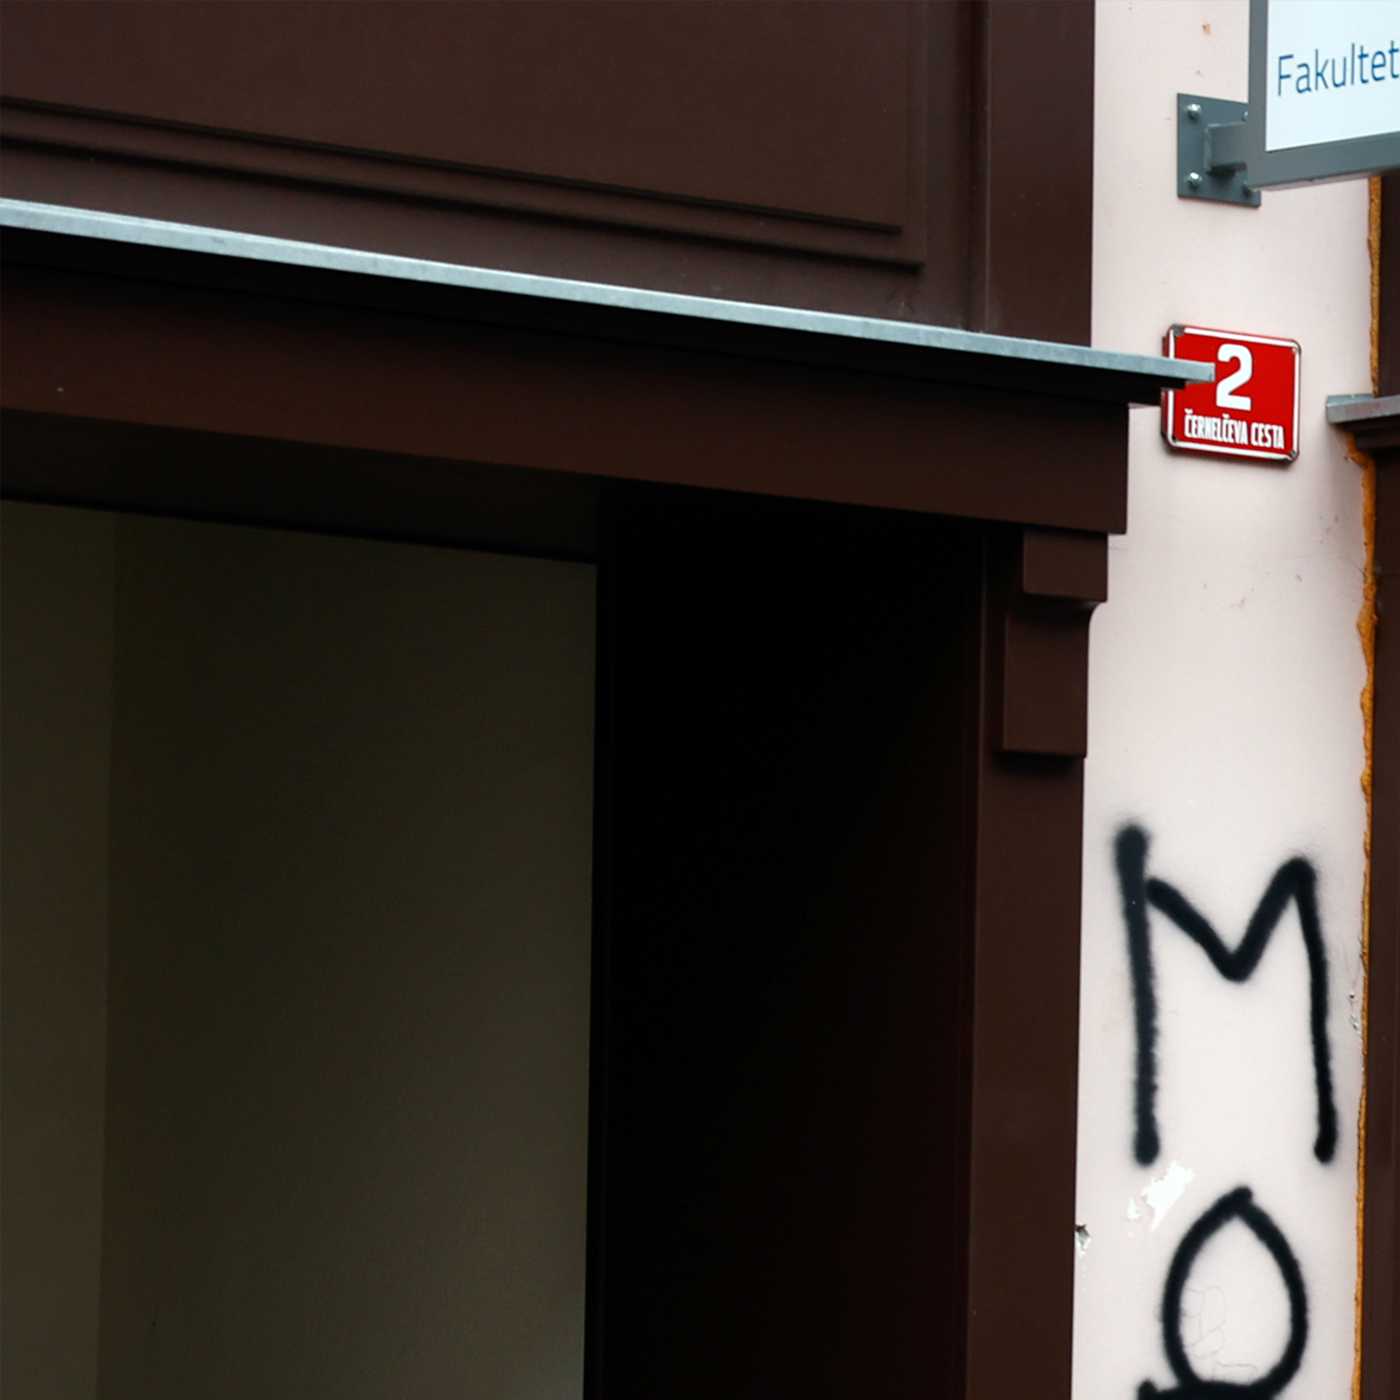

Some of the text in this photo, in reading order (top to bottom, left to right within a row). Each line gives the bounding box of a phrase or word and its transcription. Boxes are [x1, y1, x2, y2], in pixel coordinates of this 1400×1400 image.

[1215, 343, 1254, 412] 2
[1184, 408, 1285, 450] ČERNELČEVA CESTA
